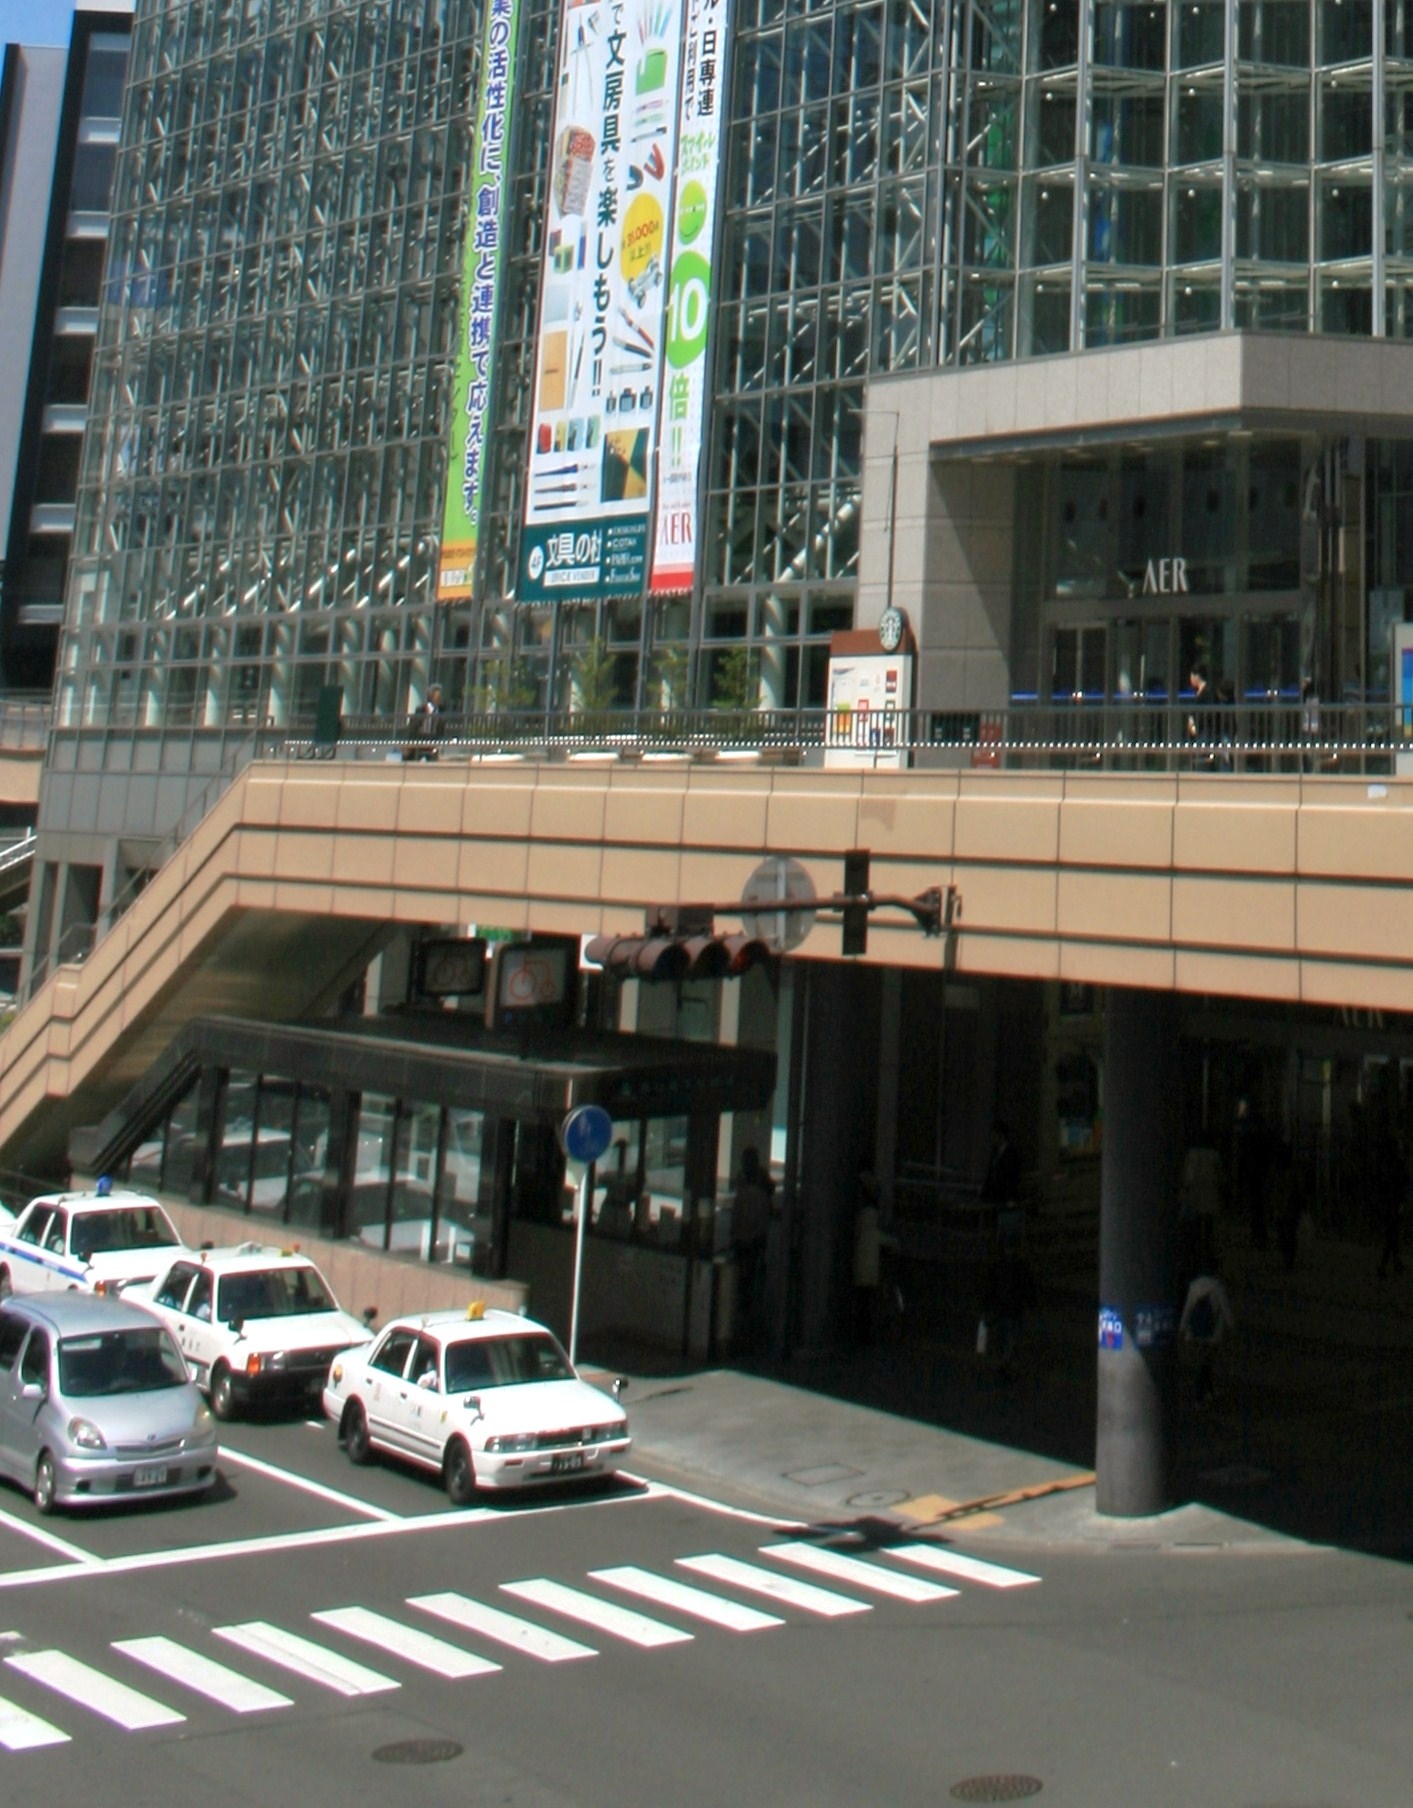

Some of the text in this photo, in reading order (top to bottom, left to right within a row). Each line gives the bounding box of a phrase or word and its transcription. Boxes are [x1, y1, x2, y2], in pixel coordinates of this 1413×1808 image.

[661, 512, 692, 546] AER
[546, 529, 602, 569] 文具の杜
[1142, 557, 1188, 594] AER
